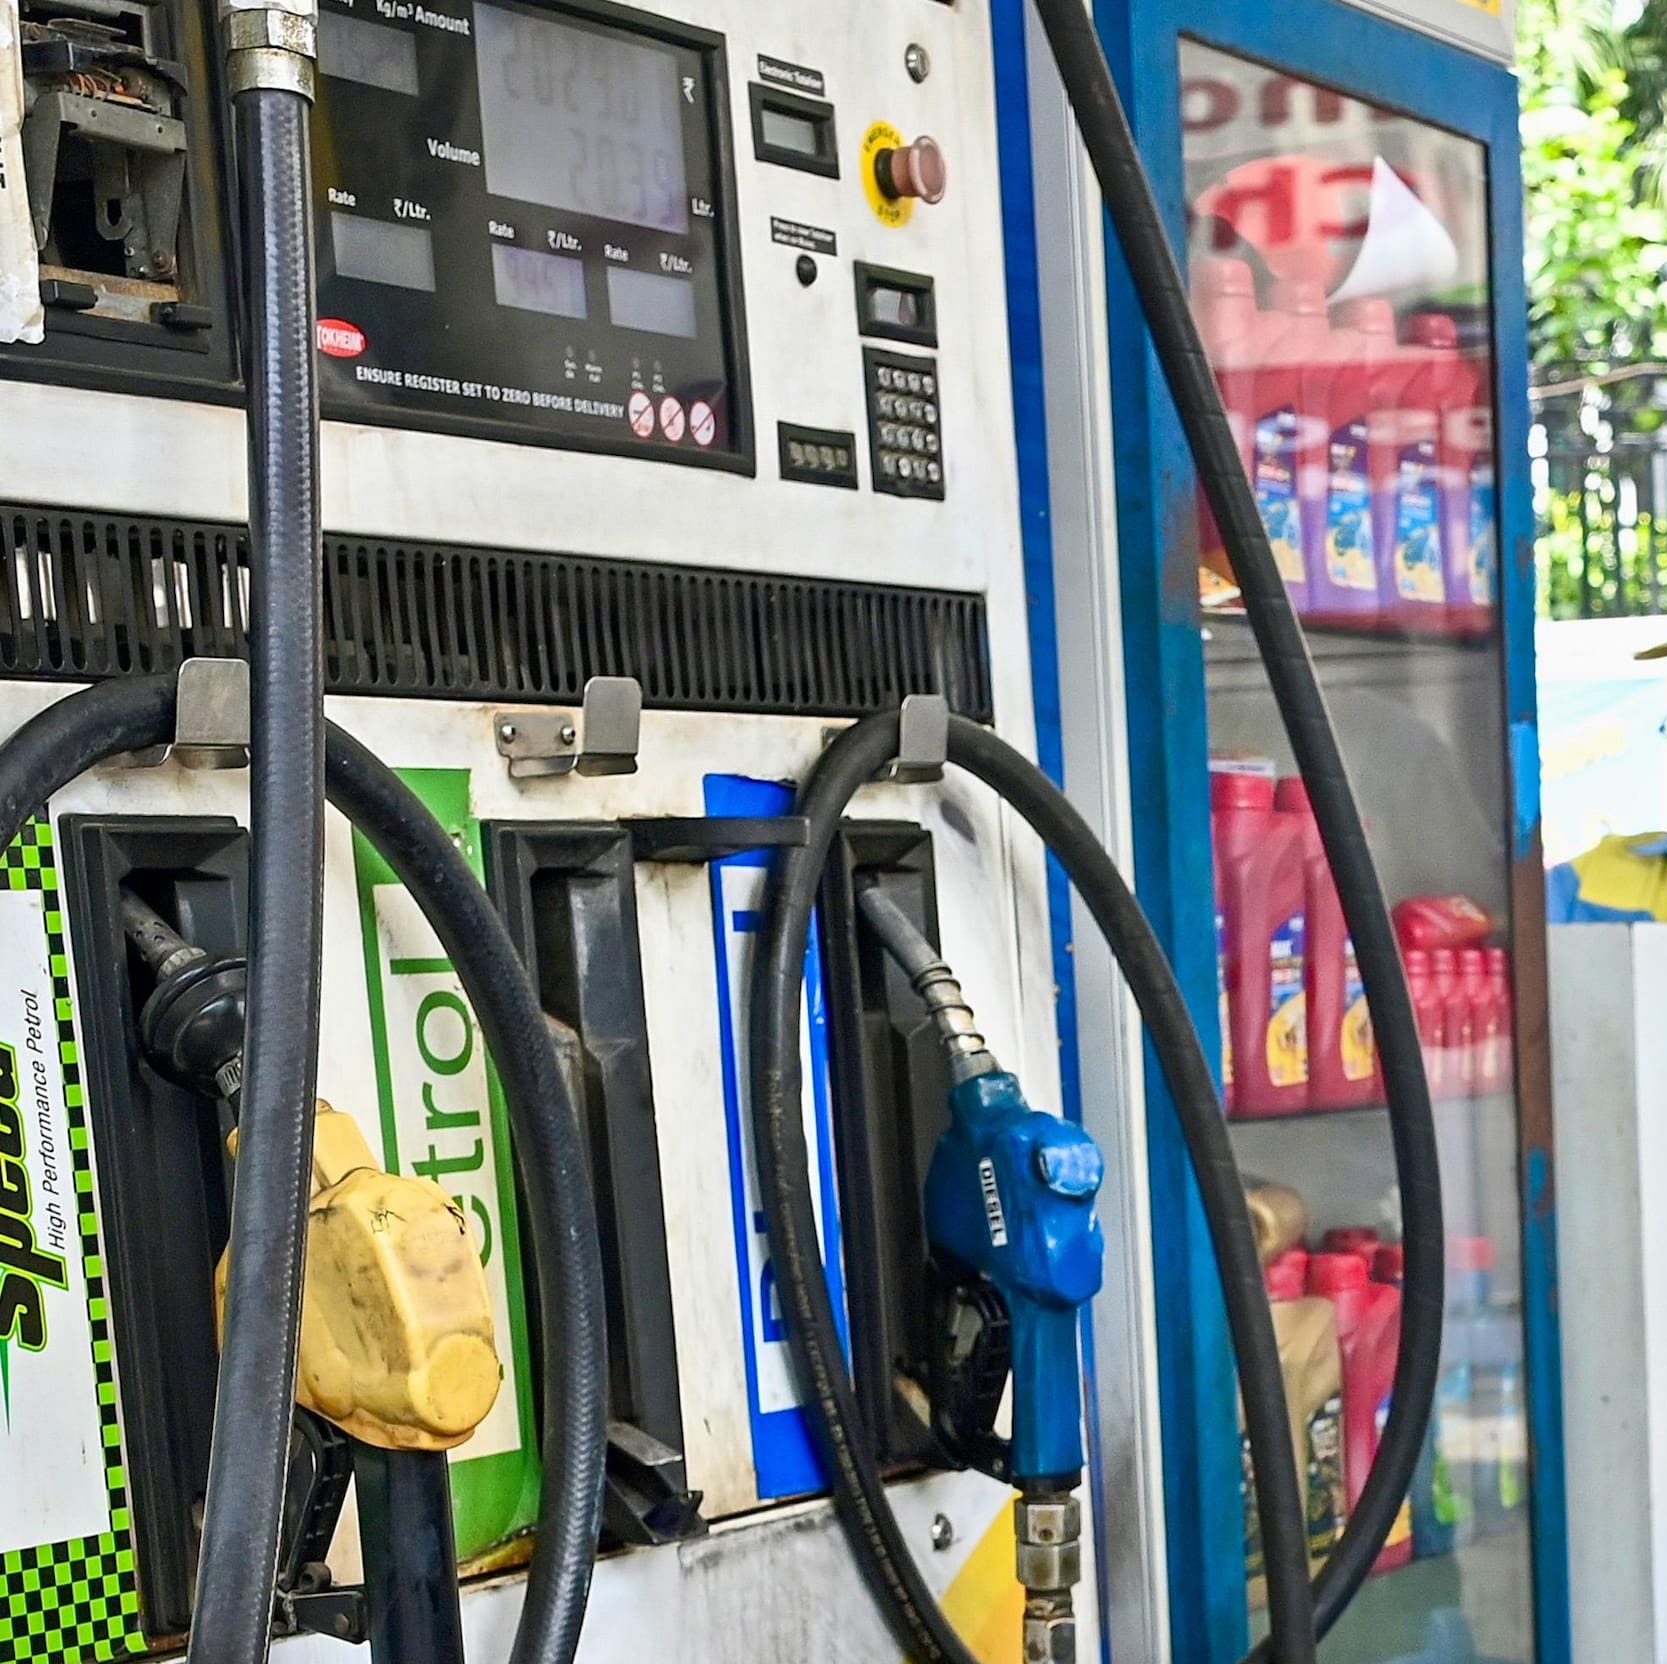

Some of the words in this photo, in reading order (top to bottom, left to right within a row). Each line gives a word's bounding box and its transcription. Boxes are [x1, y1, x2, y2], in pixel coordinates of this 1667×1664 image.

[415, 7, 470, 35] Amount
[427, 138, 480, 166] Volume
[327, 187, 356, 207] Rate
[488, 220, 516, 240] Rate
[604, 244, 629, 262] Rate
[356, 366, 404, 387] ENSURE
[404, 372, 461, 396] REGISTER
[462, 381, 483, 398] SET
[484, 384, 501, 401] TO
[501, 387, 531, 406] ZERO
[531, 392, 573, 412] BEFORE
[574, 397, 625, 419] DELIVERY
[26, 988, 43, 1054] Petrol
[35, 1060, 58, 1199] Performance
[48, 1202, 67, 1251] High
